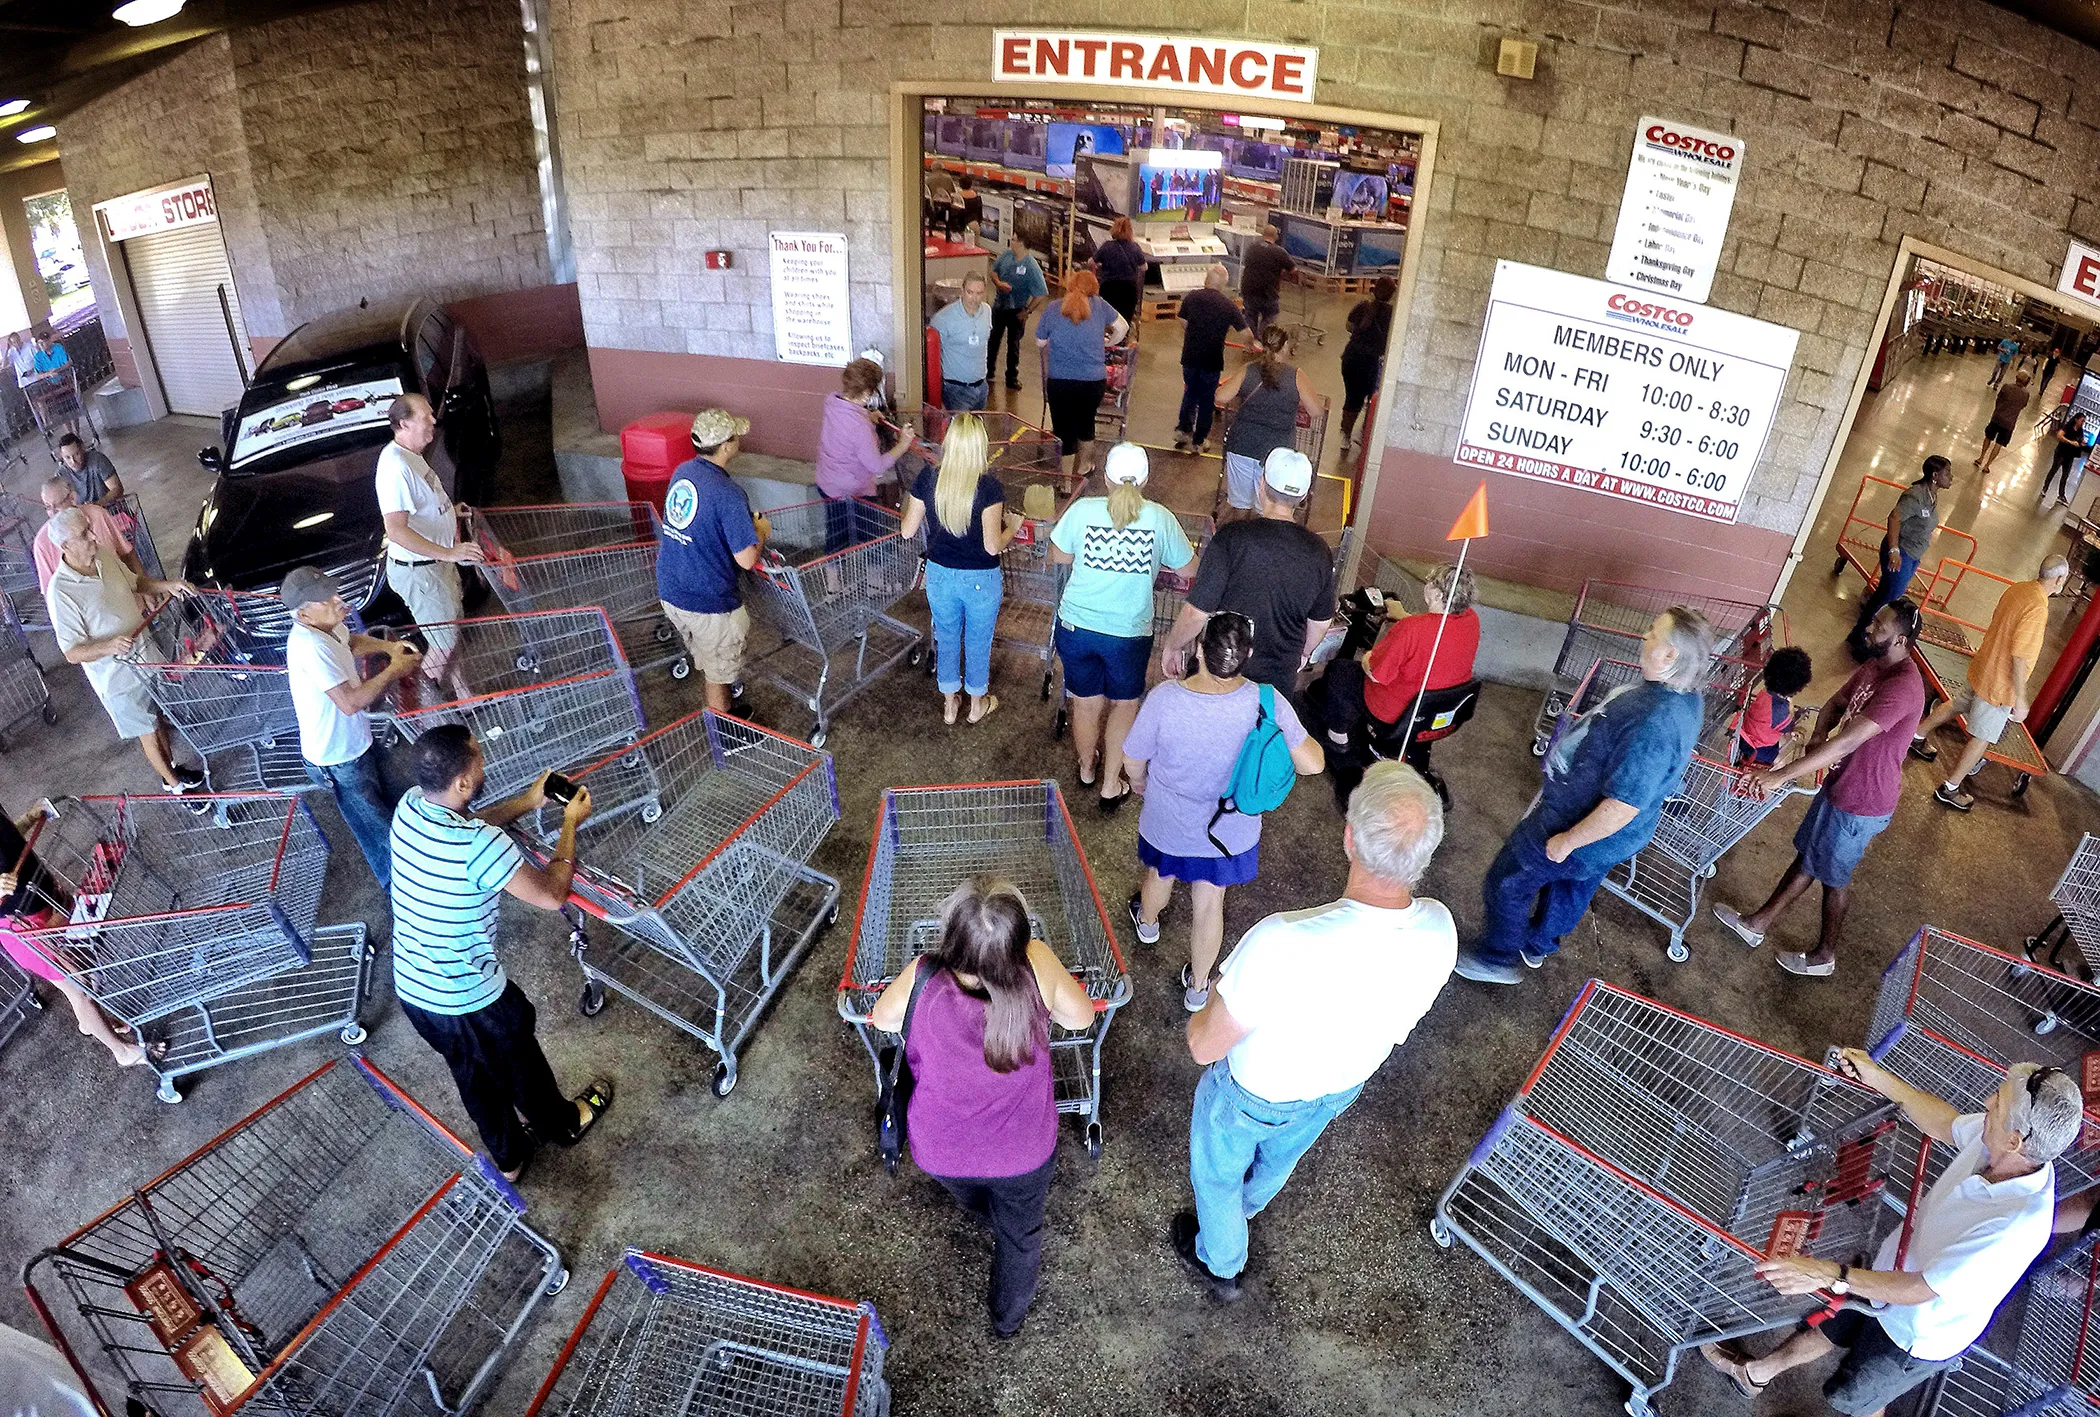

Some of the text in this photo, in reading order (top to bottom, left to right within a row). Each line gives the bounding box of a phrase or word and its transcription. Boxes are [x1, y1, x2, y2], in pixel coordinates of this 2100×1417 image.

[1002, 37, 1306, 94] ENTRANCE
[1645, 125, 1735, 160] COSTCO
[1673, 149, 1733, 170] WHOLESALE
[775, 239, 842, 254] Thank You For...
[1636, 271, 1683, 292] Christmas Day
[1639, 255, 1696, 278] Thanksgiving Day
[1607, 293, 1694, 327] COSTCO
[1631, 316, 1689, 336] WHOLESALE
[1553, 325, 1725, 382] MEMBERS ONLY
[1504, 352, 1556, 380] MON
[1573, 367, 1609, 393] FRI
[1642, 383, 1693, 412] 10:00
[1709, 401, 1750, 427] 8:30
[1495, 387, 1609, 428] SATURDAY
[1640, 420, 1682, 446] 9:30
[1698, 435, 1739, 460] 6:00
[1487, 421, 1573, 455] SUNDAY
[1621, 451, 1671, 479] 10:00
[1686, 467, 1727, 492] 6:00
[1460, 446, 1736, 520] OPEN 24 HOURS A DAY AT WWW.COSTCO.COM
